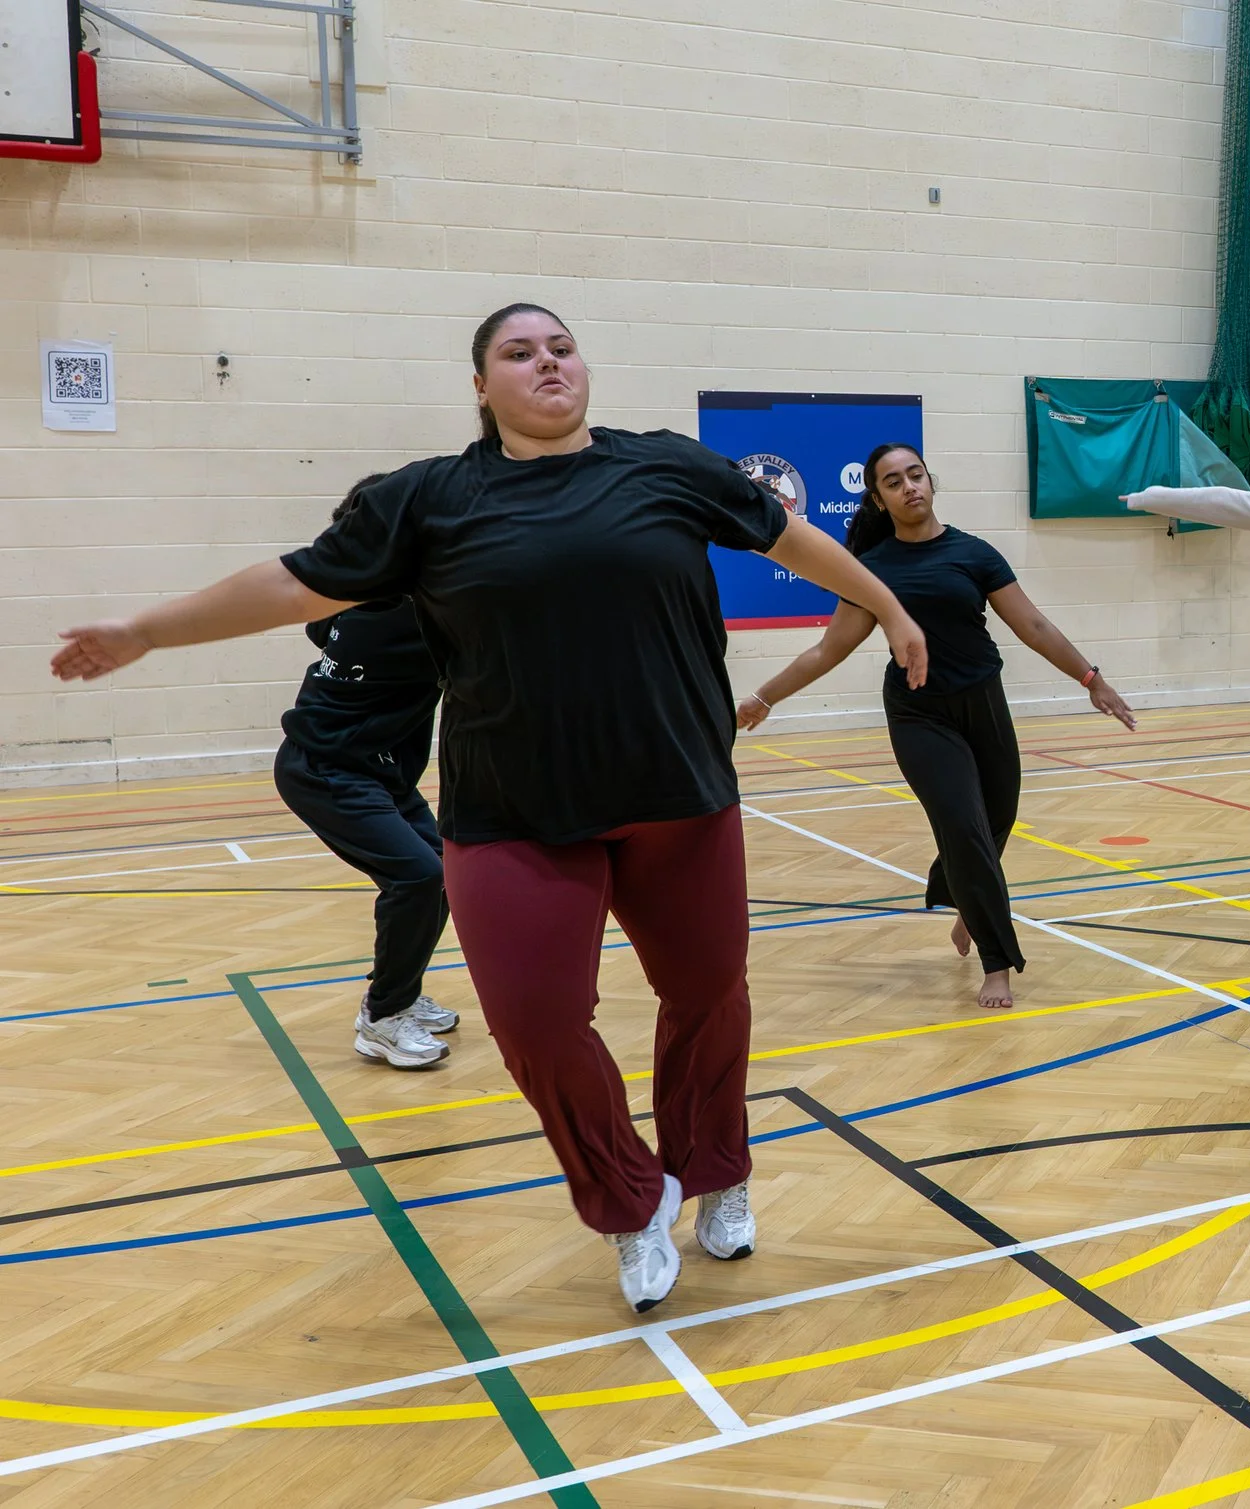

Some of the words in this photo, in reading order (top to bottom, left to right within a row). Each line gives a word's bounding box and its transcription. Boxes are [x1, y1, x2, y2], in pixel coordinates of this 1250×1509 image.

[738, 456, 755, 469] EES
[757, 455, 795, 474] VALLEY
[820, 501, 861, 514] Middle
[774, 568, 786, 580] in
